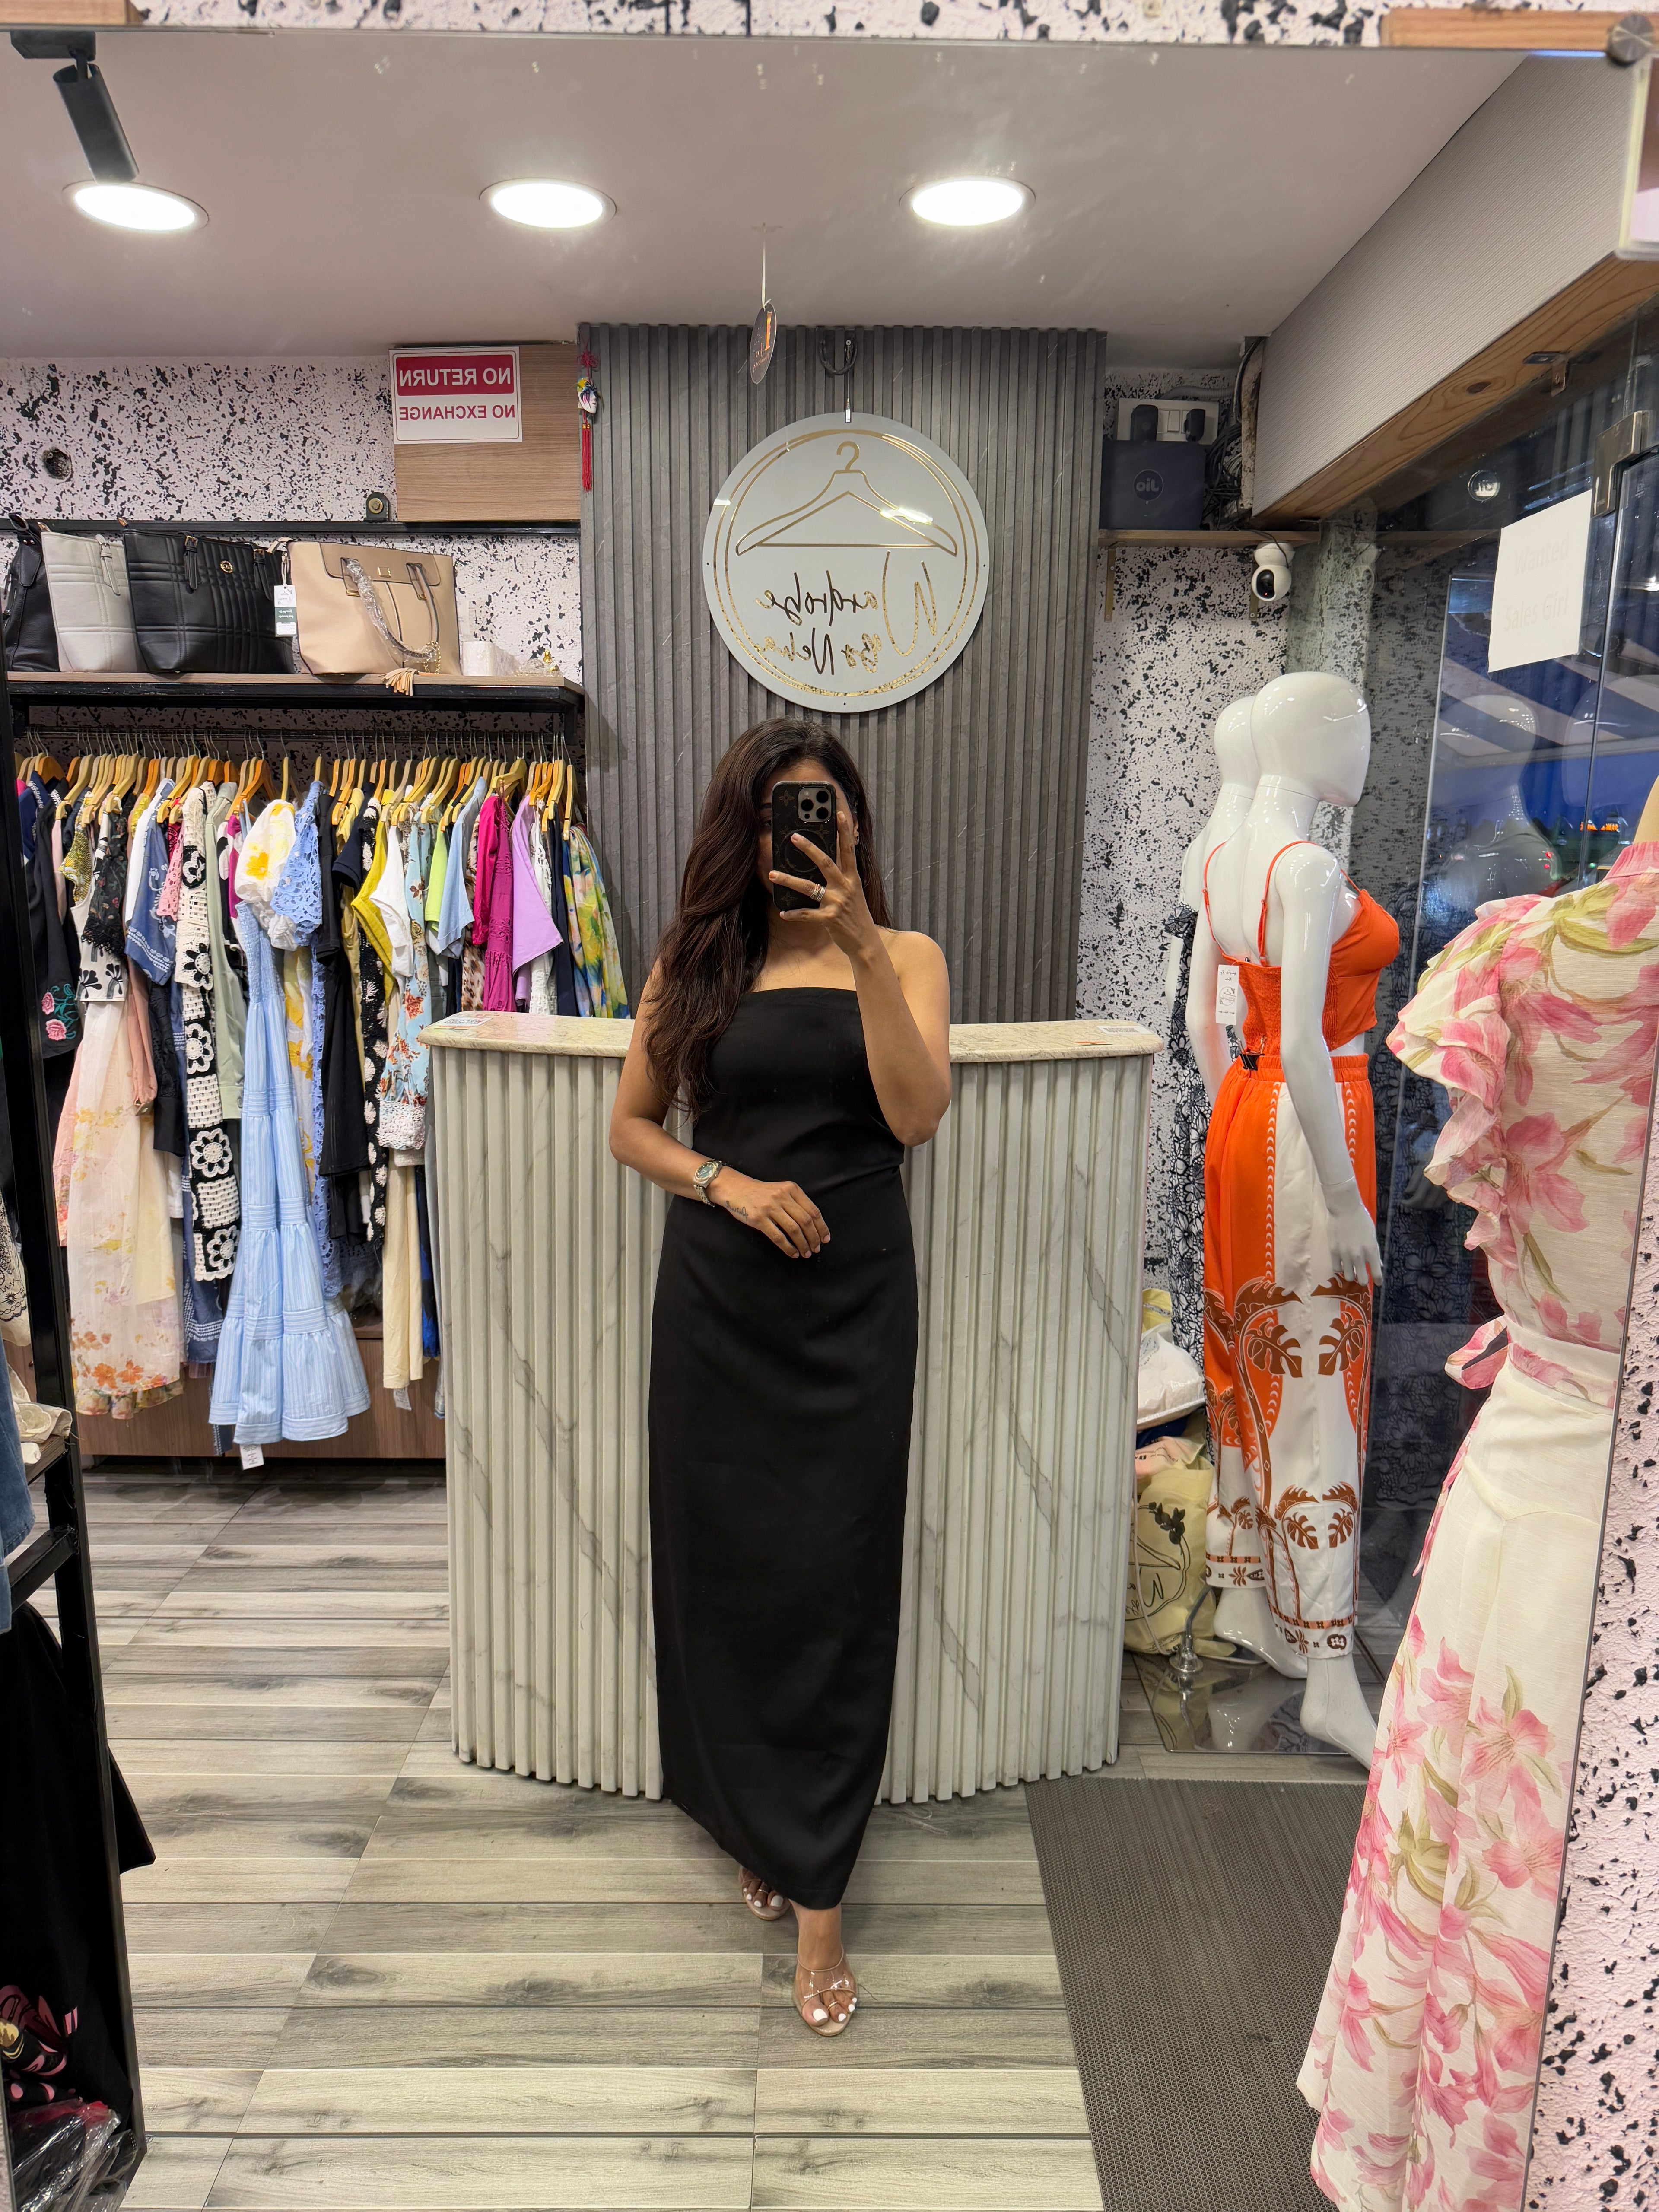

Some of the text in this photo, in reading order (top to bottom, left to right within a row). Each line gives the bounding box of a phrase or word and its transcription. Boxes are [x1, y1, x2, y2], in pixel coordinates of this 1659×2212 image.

[1514, 529, 1570, 577] Wanted
[1504, 587, 1569, 632] Sales Girl
